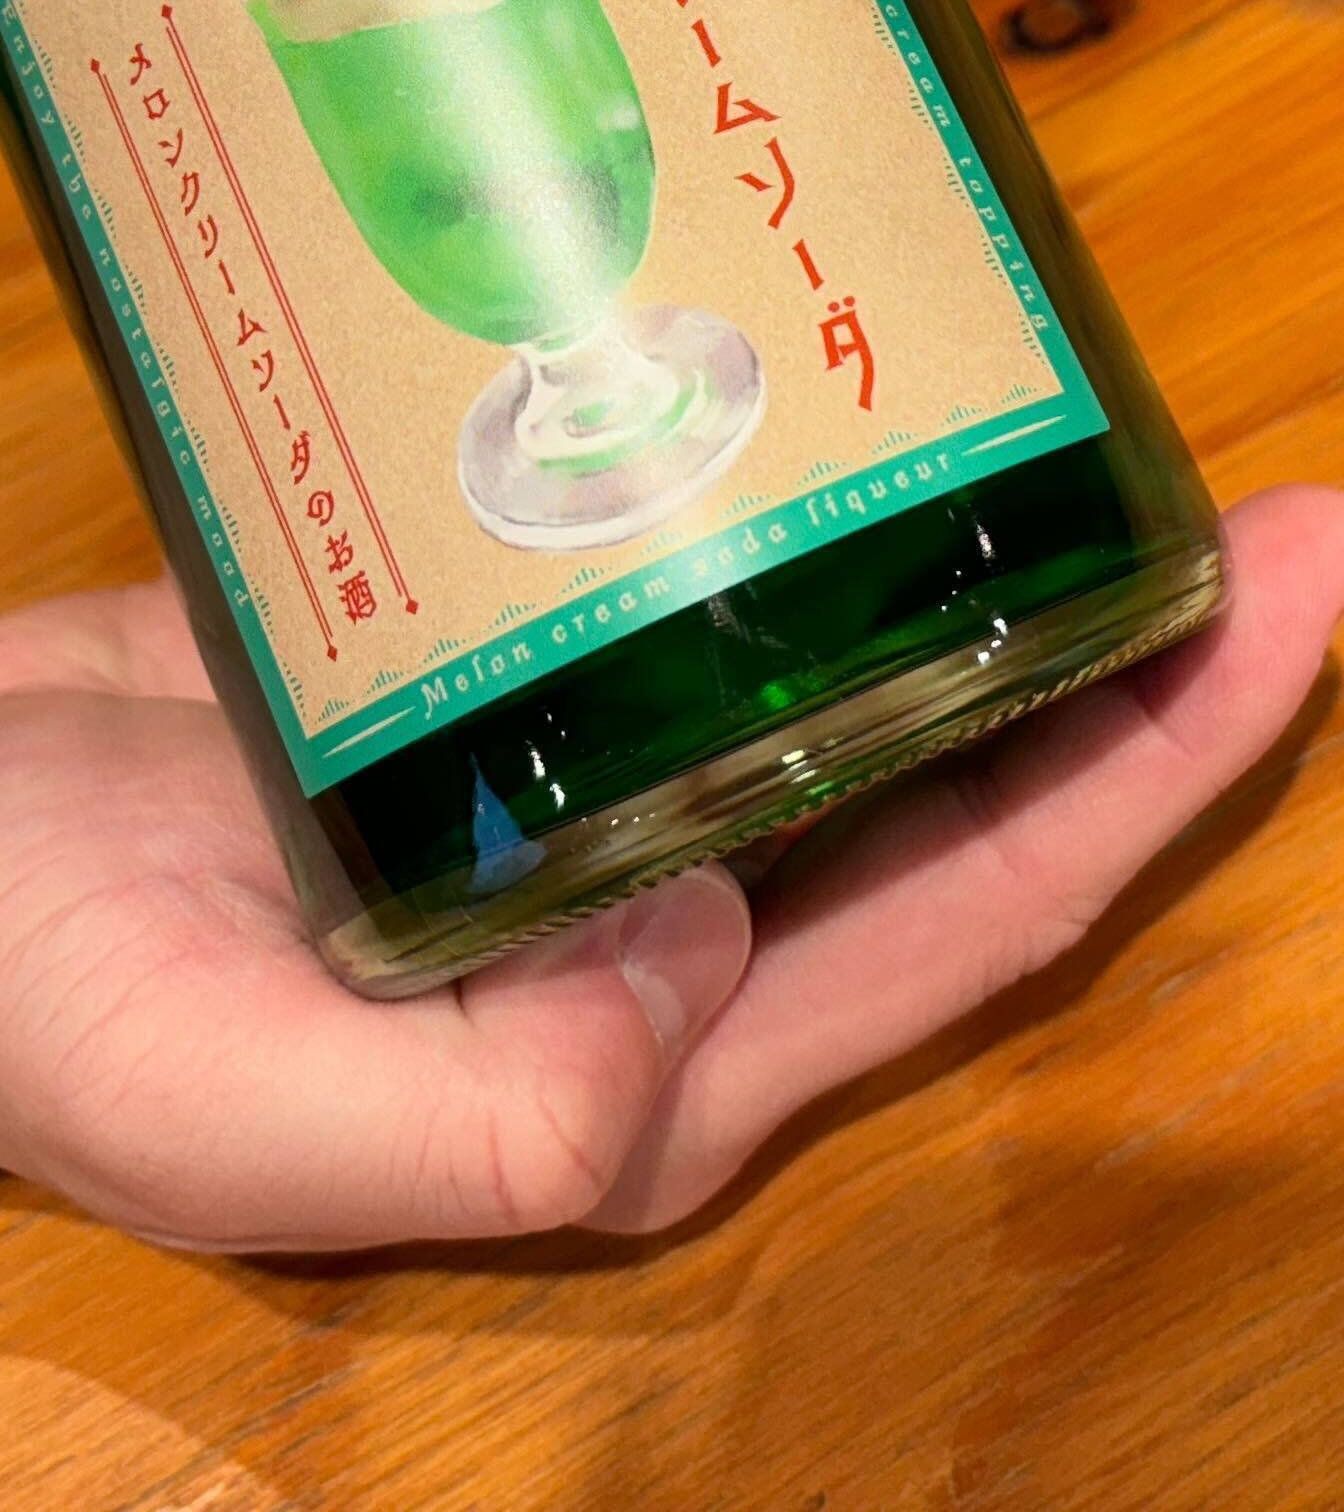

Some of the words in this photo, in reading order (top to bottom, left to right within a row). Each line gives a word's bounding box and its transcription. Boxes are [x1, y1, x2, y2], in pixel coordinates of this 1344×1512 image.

[1, 0, 55, 124] Enjoy
[62, 152, 91, 220] the
[99, 247, 190, 466] nostalgic
[199, 495, 249, 608] mood
[128, 43, 377, 626] メロンクリームソーダのお酒
[885, 4, 951, 128] cream
[959, 156, 1048, 329] topping
[420, 640, 533, 721] Melon
[551, 575, 672, 644] cream
[692, 527, 789, 578] soda
[806, 452, 952, 526] liqueur
